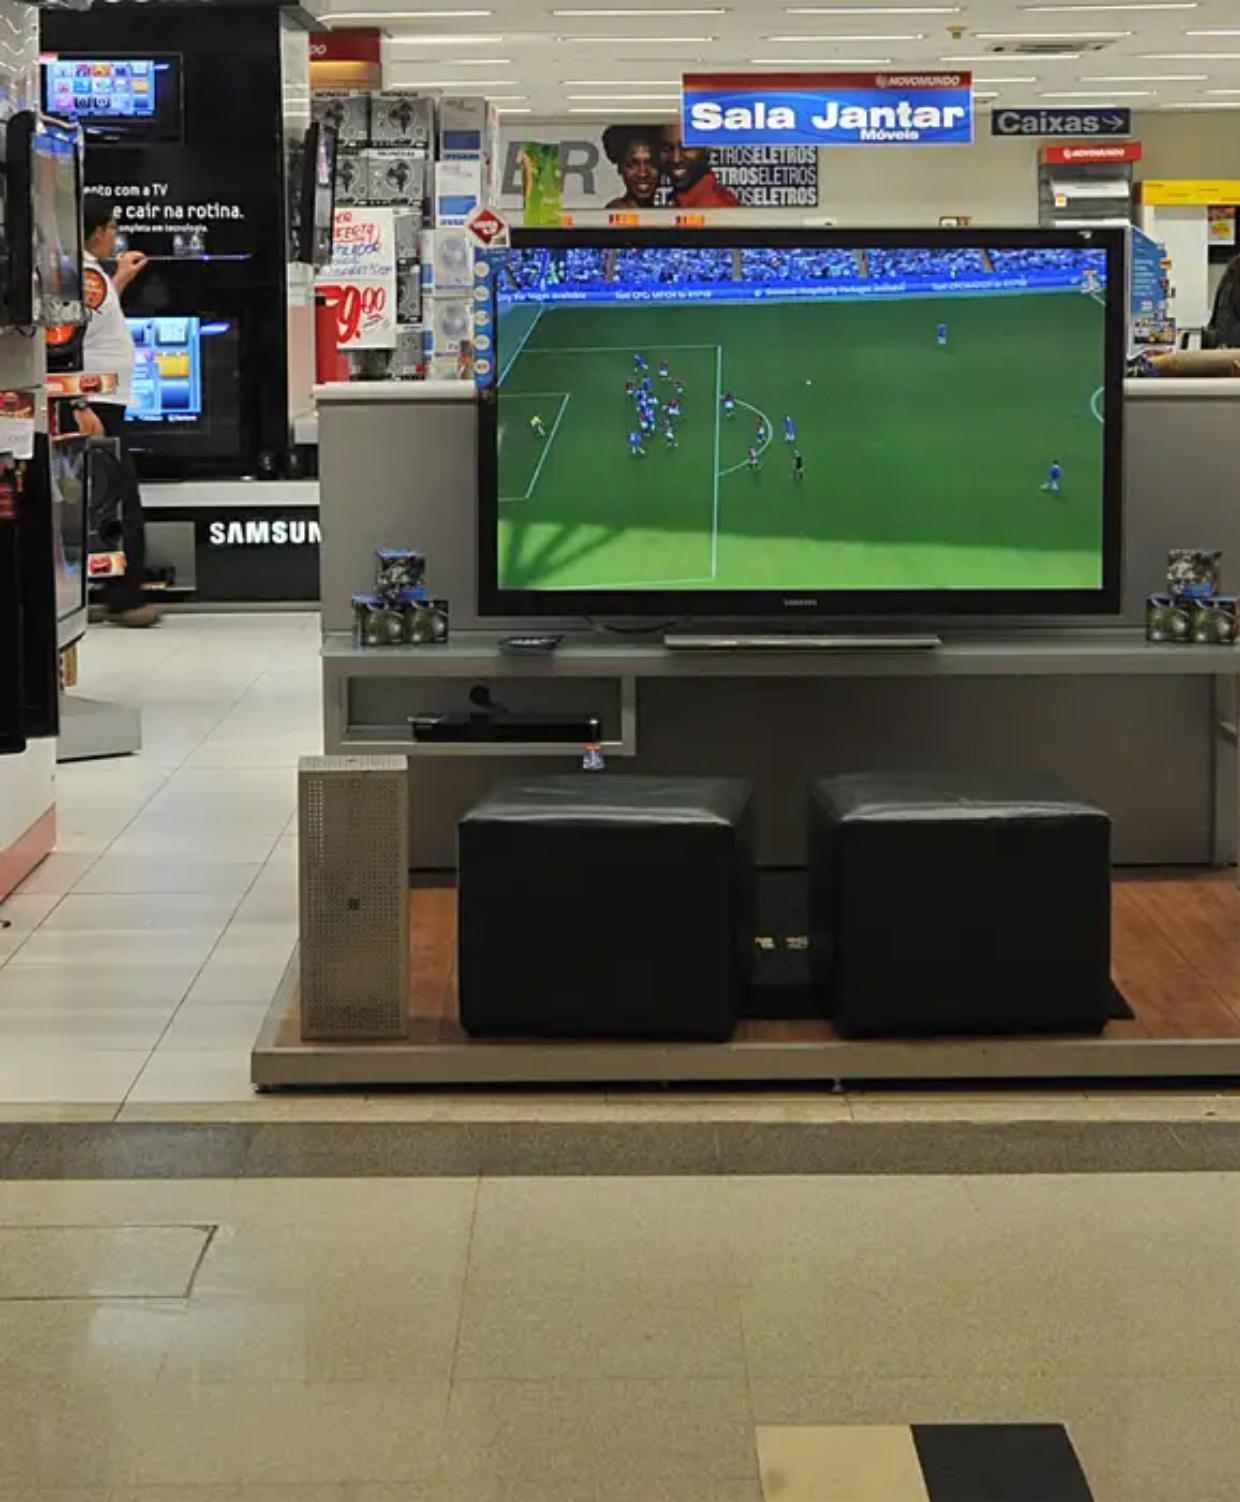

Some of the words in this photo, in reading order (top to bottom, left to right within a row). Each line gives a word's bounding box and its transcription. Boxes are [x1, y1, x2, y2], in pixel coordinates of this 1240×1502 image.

[887, 76, 961, 86] NOVOMUNDO
[691, 102, 795, 130] Sala
[811, 102, 964, 129] Jantar
[997, 111, 1100, 133] Caixas
[860, 127, 919, 141] Móveis
[115, 186, 140, 197] com
[142, 187, 150, 197] a
[152, 183, 169, 197] TV
[112, 206, 123, 219] e
[164, 206, 184, 219] na
[187, 201, 244, 220] rotina.
